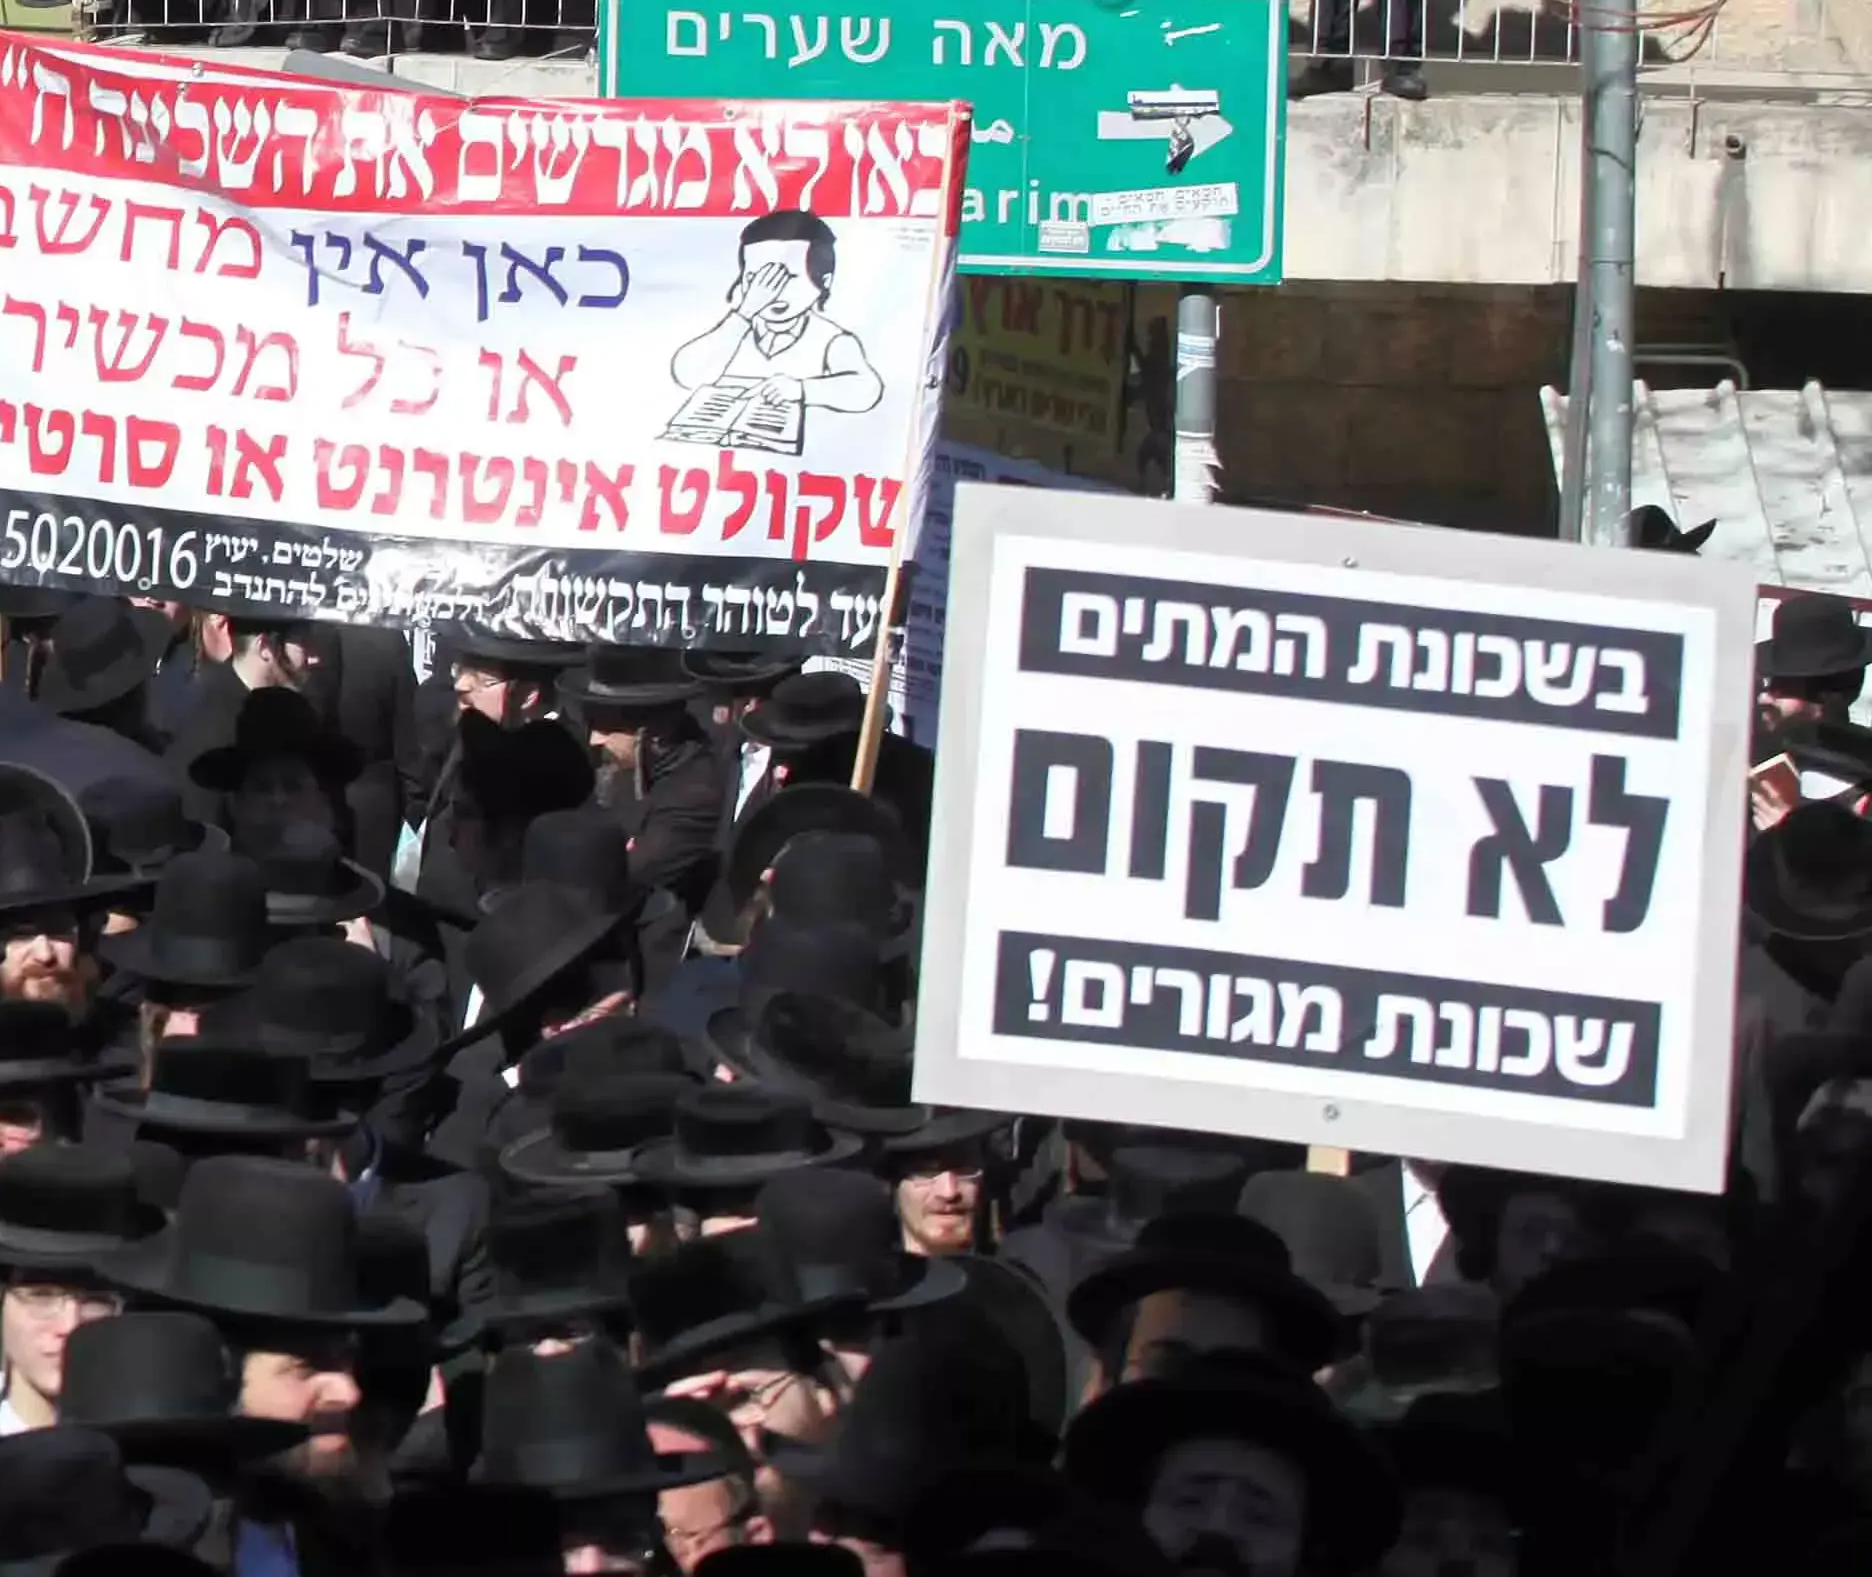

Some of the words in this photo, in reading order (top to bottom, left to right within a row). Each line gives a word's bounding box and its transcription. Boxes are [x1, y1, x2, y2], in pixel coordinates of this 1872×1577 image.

[666, 9, 891, 70] שערים
[932, 19, 1088, 71] מאה
[89, 77, 319, 190] השכינה
[332, 93, 438, 200] את
[457, 109, 713, 210] מגרשים
[730, 109, 832, 213] לא
[843, 116, 948, 220] כאן
[960, 179, 1094, 224] arim
[290, 228, 430, 307] אין
[462, 239, 630, 322] כאן
[2, 292, 298, 402] מכשיר
[337, 311, 444, 415] כל
[478, 346, 578, 428] או
[205, 423, 288, 503] או
[313, 437, 636, 532] אינטרנט
[658, 450, 906, 563] שקולט
[204, 532, 258, 564] יעוץ
[212, 571, 327, 606] להתנדב
[702, 570, 819, 636] לטוהר
[830, 587, 887, 649] עד
[1057, 589, 1328, 680] המתים
[1346, 620, 1651, 716] בשכונת
[1004, 726, 1414, 924] תקום
[1464, 752, 1672, 936] לא
[1026, 946, 1344, 1055] מגורים!
[1362, 991, 1637, 1088] שכונת
